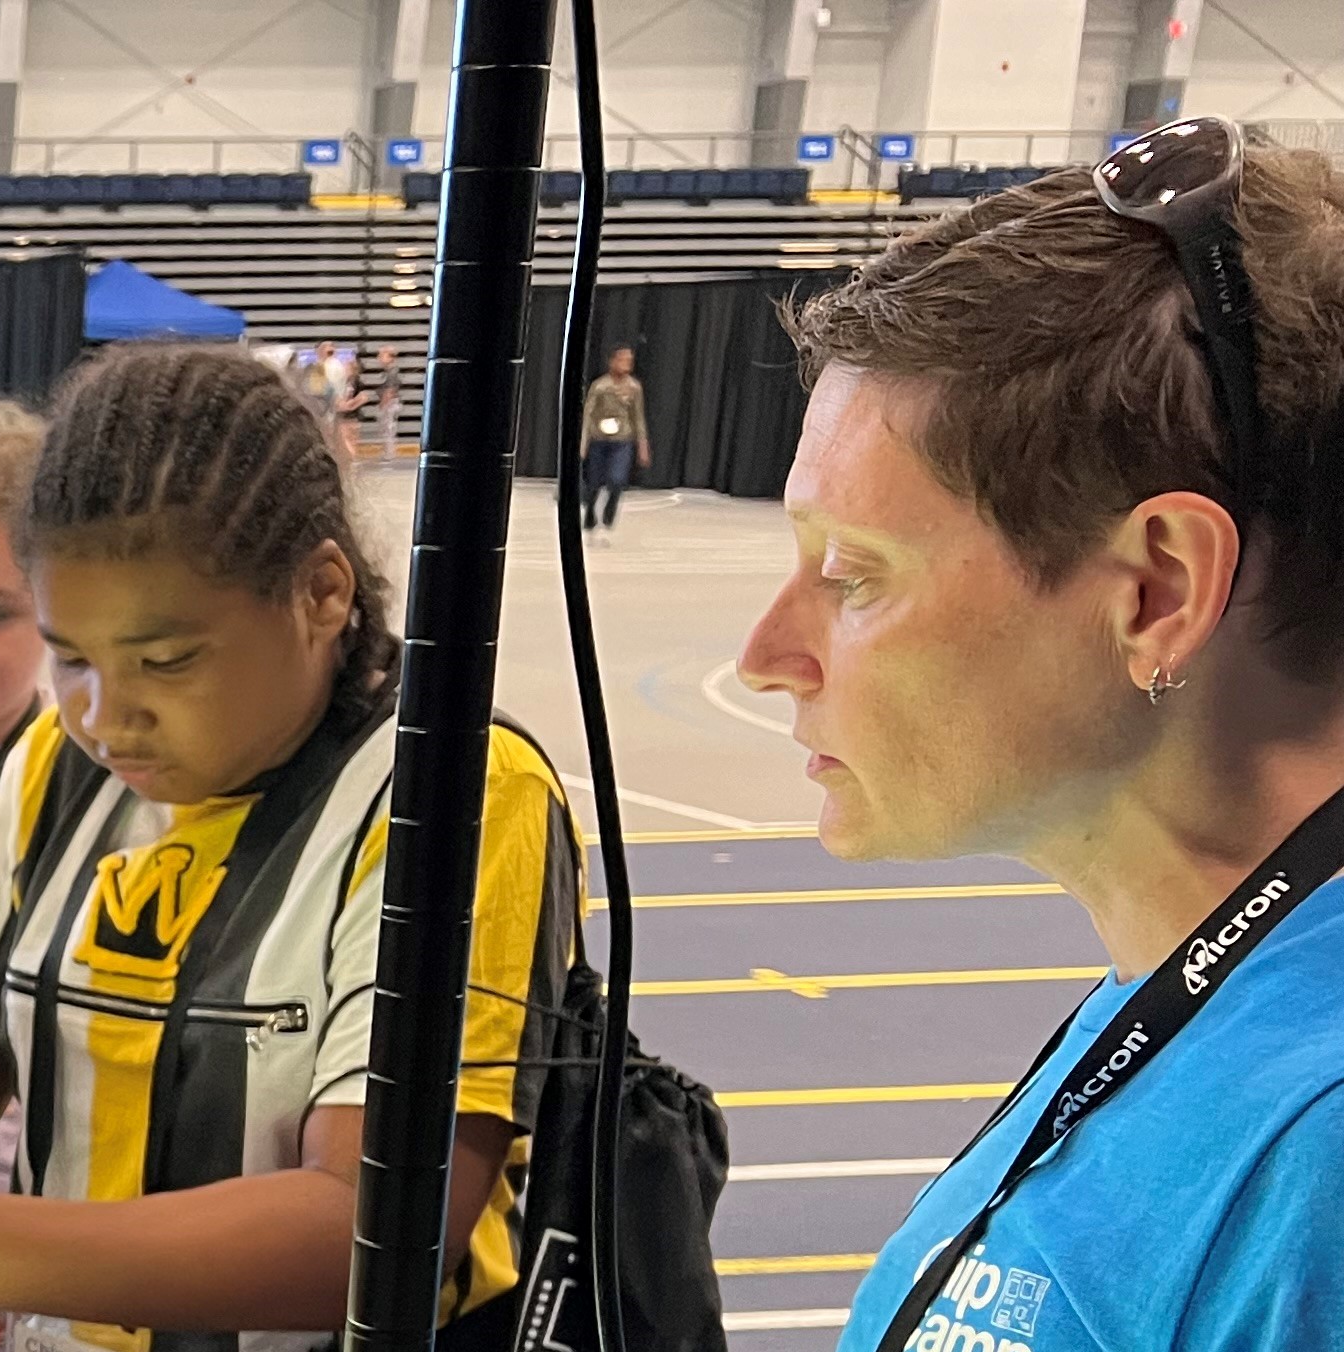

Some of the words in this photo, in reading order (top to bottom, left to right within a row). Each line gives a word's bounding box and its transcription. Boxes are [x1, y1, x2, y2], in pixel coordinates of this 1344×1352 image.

[1209, 245, 1232, 313] NATIVE
[1182, 871, 1291, 995] Micron
[1053, 1022, 1149, 1139] Micron
